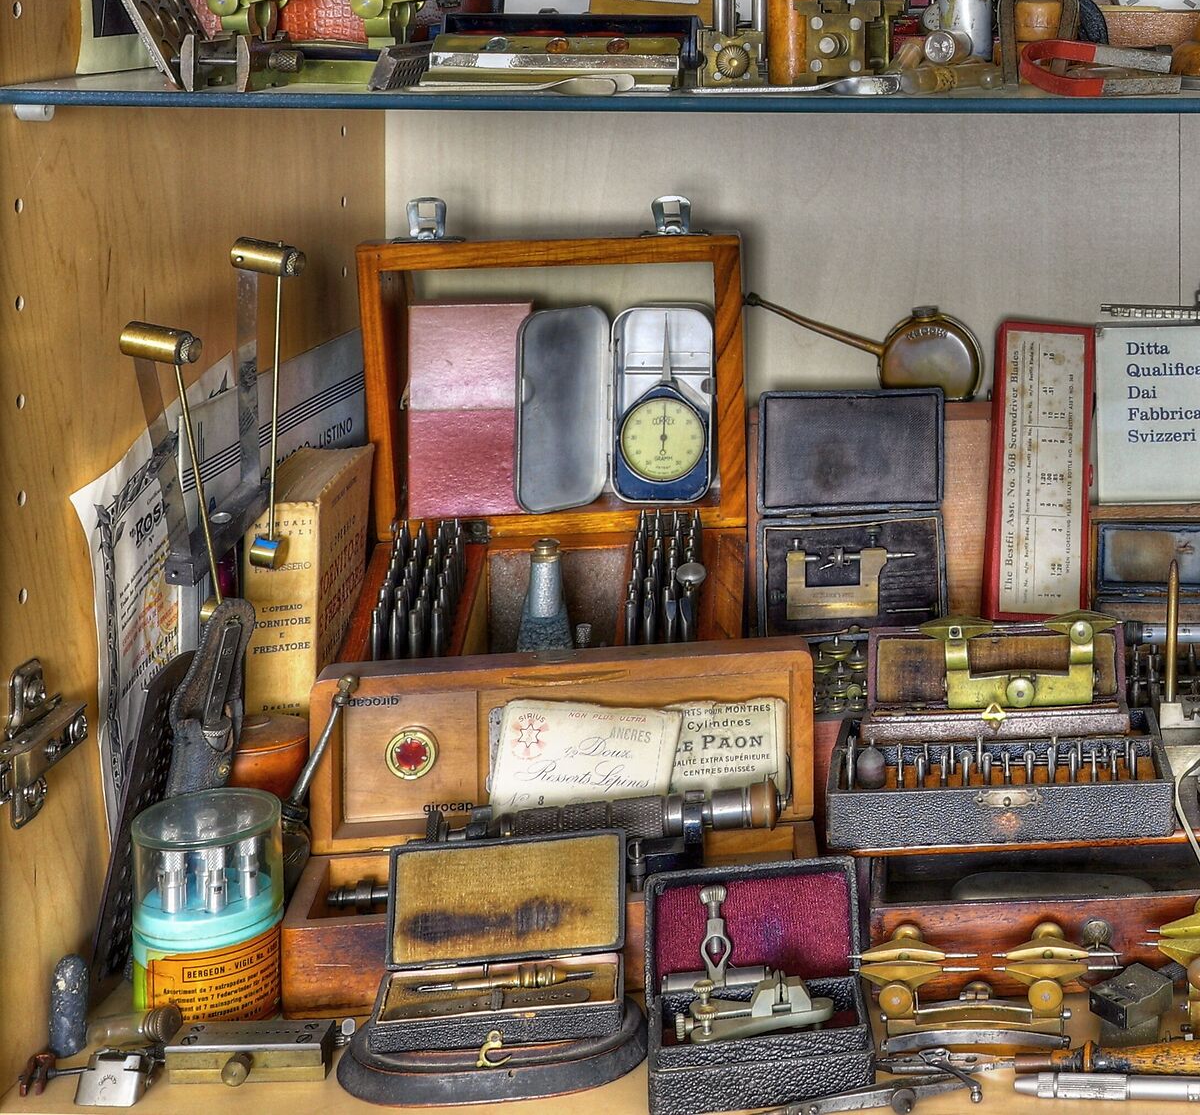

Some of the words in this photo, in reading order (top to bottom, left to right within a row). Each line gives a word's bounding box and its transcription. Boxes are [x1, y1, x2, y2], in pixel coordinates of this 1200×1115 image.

[1126, 342, 1170, 356] Ditta
[1010, 350, 1019, 383] Blades
[1127, 386, 1157, 400] Dai
[1009, 387, 1018, 450] Screwdriver
[318, 416, 354, 448] LISTINO
[1128, 429, 1197, 444] Svizzeri
[1008, 453, 1017, 475] 36B
[1007, 478, 1016, 498] No.
[1006, 501, 1015, 527] Asst.
[1005, 531, 1014, 567] Bestfit
[1004, 572, 1013, 591] The
[261, 603, 303, 614] L'OPERAIO
[254, 616, 311, 630] TORNITORE
[252, 641, 311, 655] FRESATORE
[348, 695, 400, 709] girocap
[518, 712, 547, 724] SIRIUS
[568, 711, 588, 720] NON
[592, 713, 613, 721] PLUS
[619, 715, 648, 724] ULTRA
[704, 708, 723, 716] POUR
[725, 704, 771, 714] MONTRES
[687, 718, 751, 733] Cylindres
[609, 726, 652, 744] ANCRES
[701, 734, 764, 750] PAON
[700, 755, 724, 765] EXTRA
[725, 753, 771, 763] SUPÉRIEURE
[683, 767, 723, 777] CENTRES
[723, 765, 756, 774] BAISSÉS
[422, 801, 474, 816] girocap
[186, 965, 225, 979] BERGEON
[234, 958, 254, 970] VIGIE
[163, 987, 197, 996] Assortiment
[168, 996, 196, 1004] Sortiment
